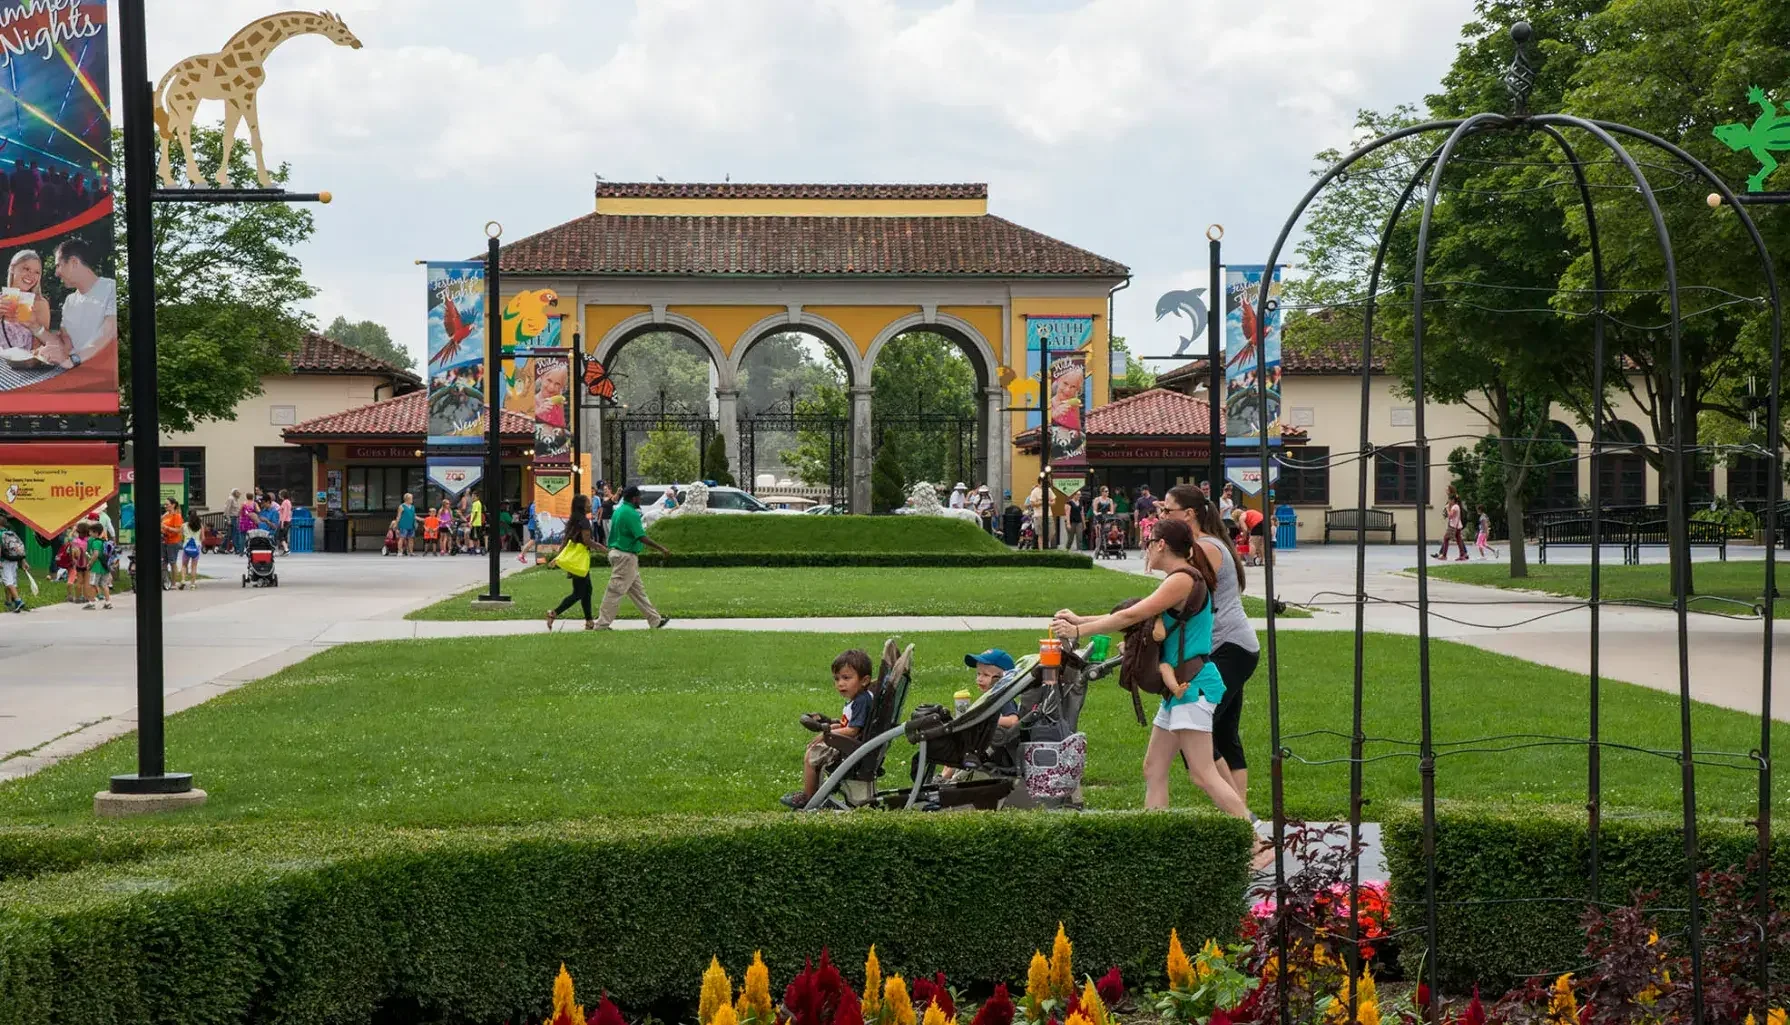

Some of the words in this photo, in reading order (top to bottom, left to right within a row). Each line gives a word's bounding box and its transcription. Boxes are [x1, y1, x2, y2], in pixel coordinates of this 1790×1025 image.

[0, 9, 102, 68] Nights
[435, 283, 476, 305] Flight
[1048, 336, 1076, 346] ATE
[449, 411, 482, 435] New!
[1101, 448, 1133, 458] SOUTH
[1135, 447, 1160, 458] GATE
[50, 481, 101, 501] meijer
